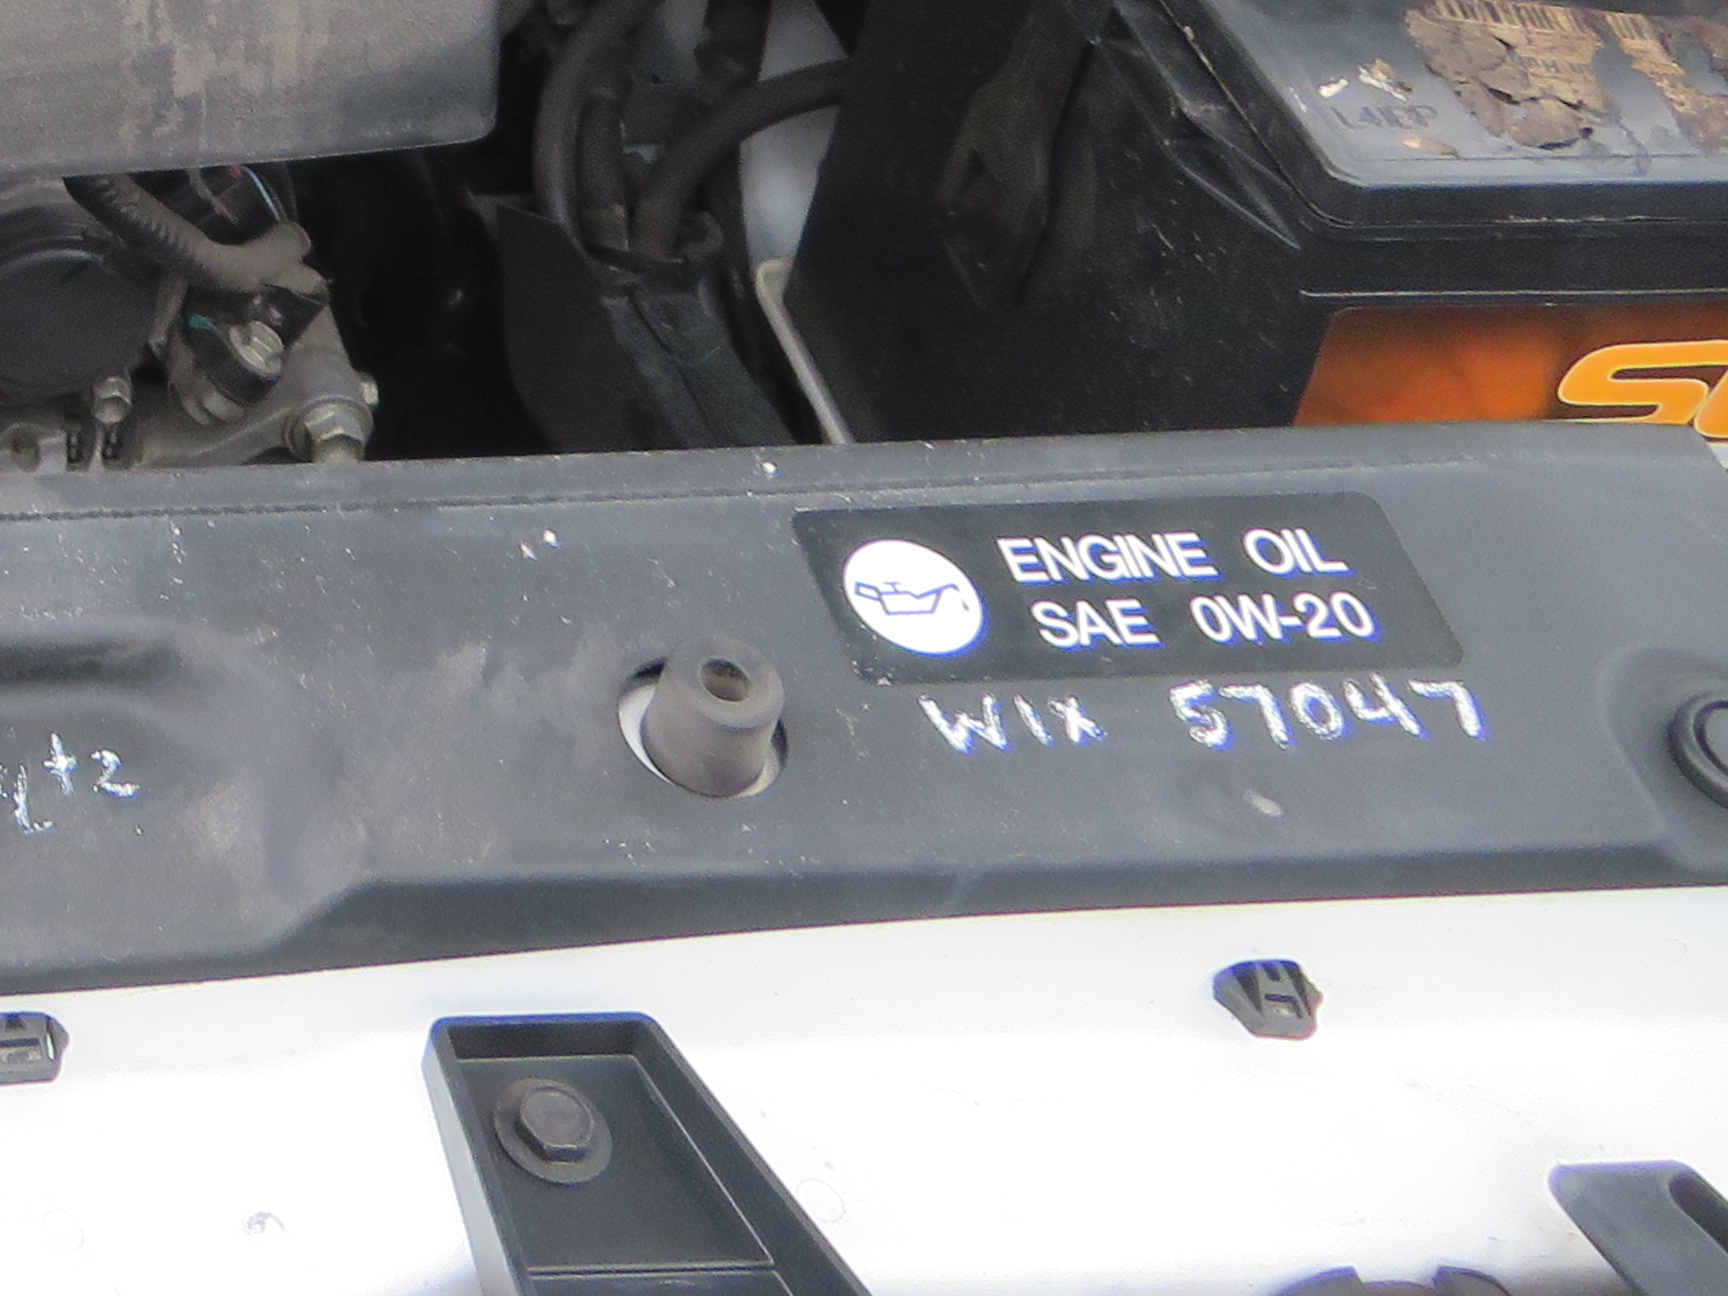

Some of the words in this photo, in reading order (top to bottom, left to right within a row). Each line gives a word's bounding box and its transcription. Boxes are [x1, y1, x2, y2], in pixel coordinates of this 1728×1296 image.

[997, 531, 1218, 585] ENGINE
[1243, 528, 1351, 575] OIL
[1028, 601, 1160, 648] SAE
[1190, 591, 1377, 647] 0W-20
[1168, 676, 1489, 749] 57047
